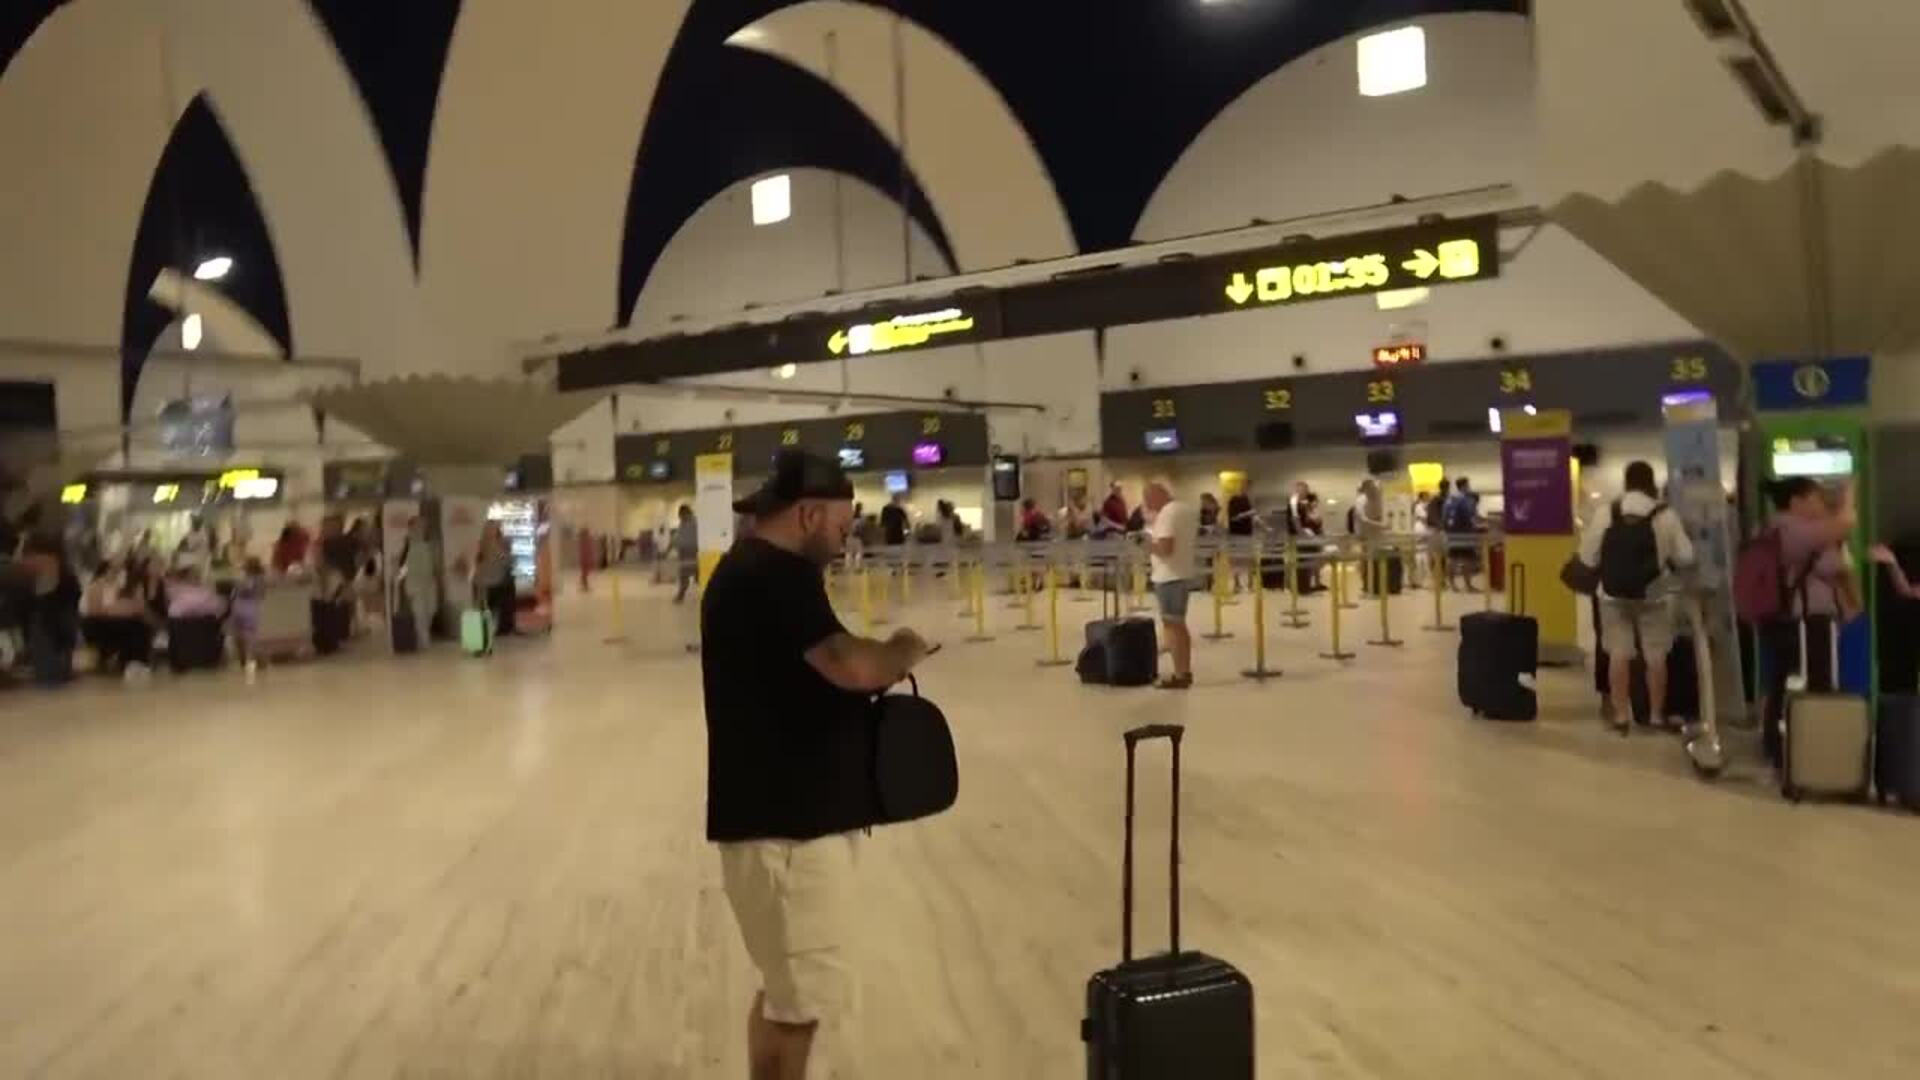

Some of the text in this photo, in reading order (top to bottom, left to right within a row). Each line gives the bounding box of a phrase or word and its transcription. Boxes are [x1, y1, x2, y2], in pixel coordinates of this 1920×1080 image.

[1672, 357, 1706, 381] 35
[1367, 381, 1394, 402] 33
[1500, 369, 1531, 393] 34
[1151, 399, 1175, 418] 31
[1264, 389, 1291, 409] 32
